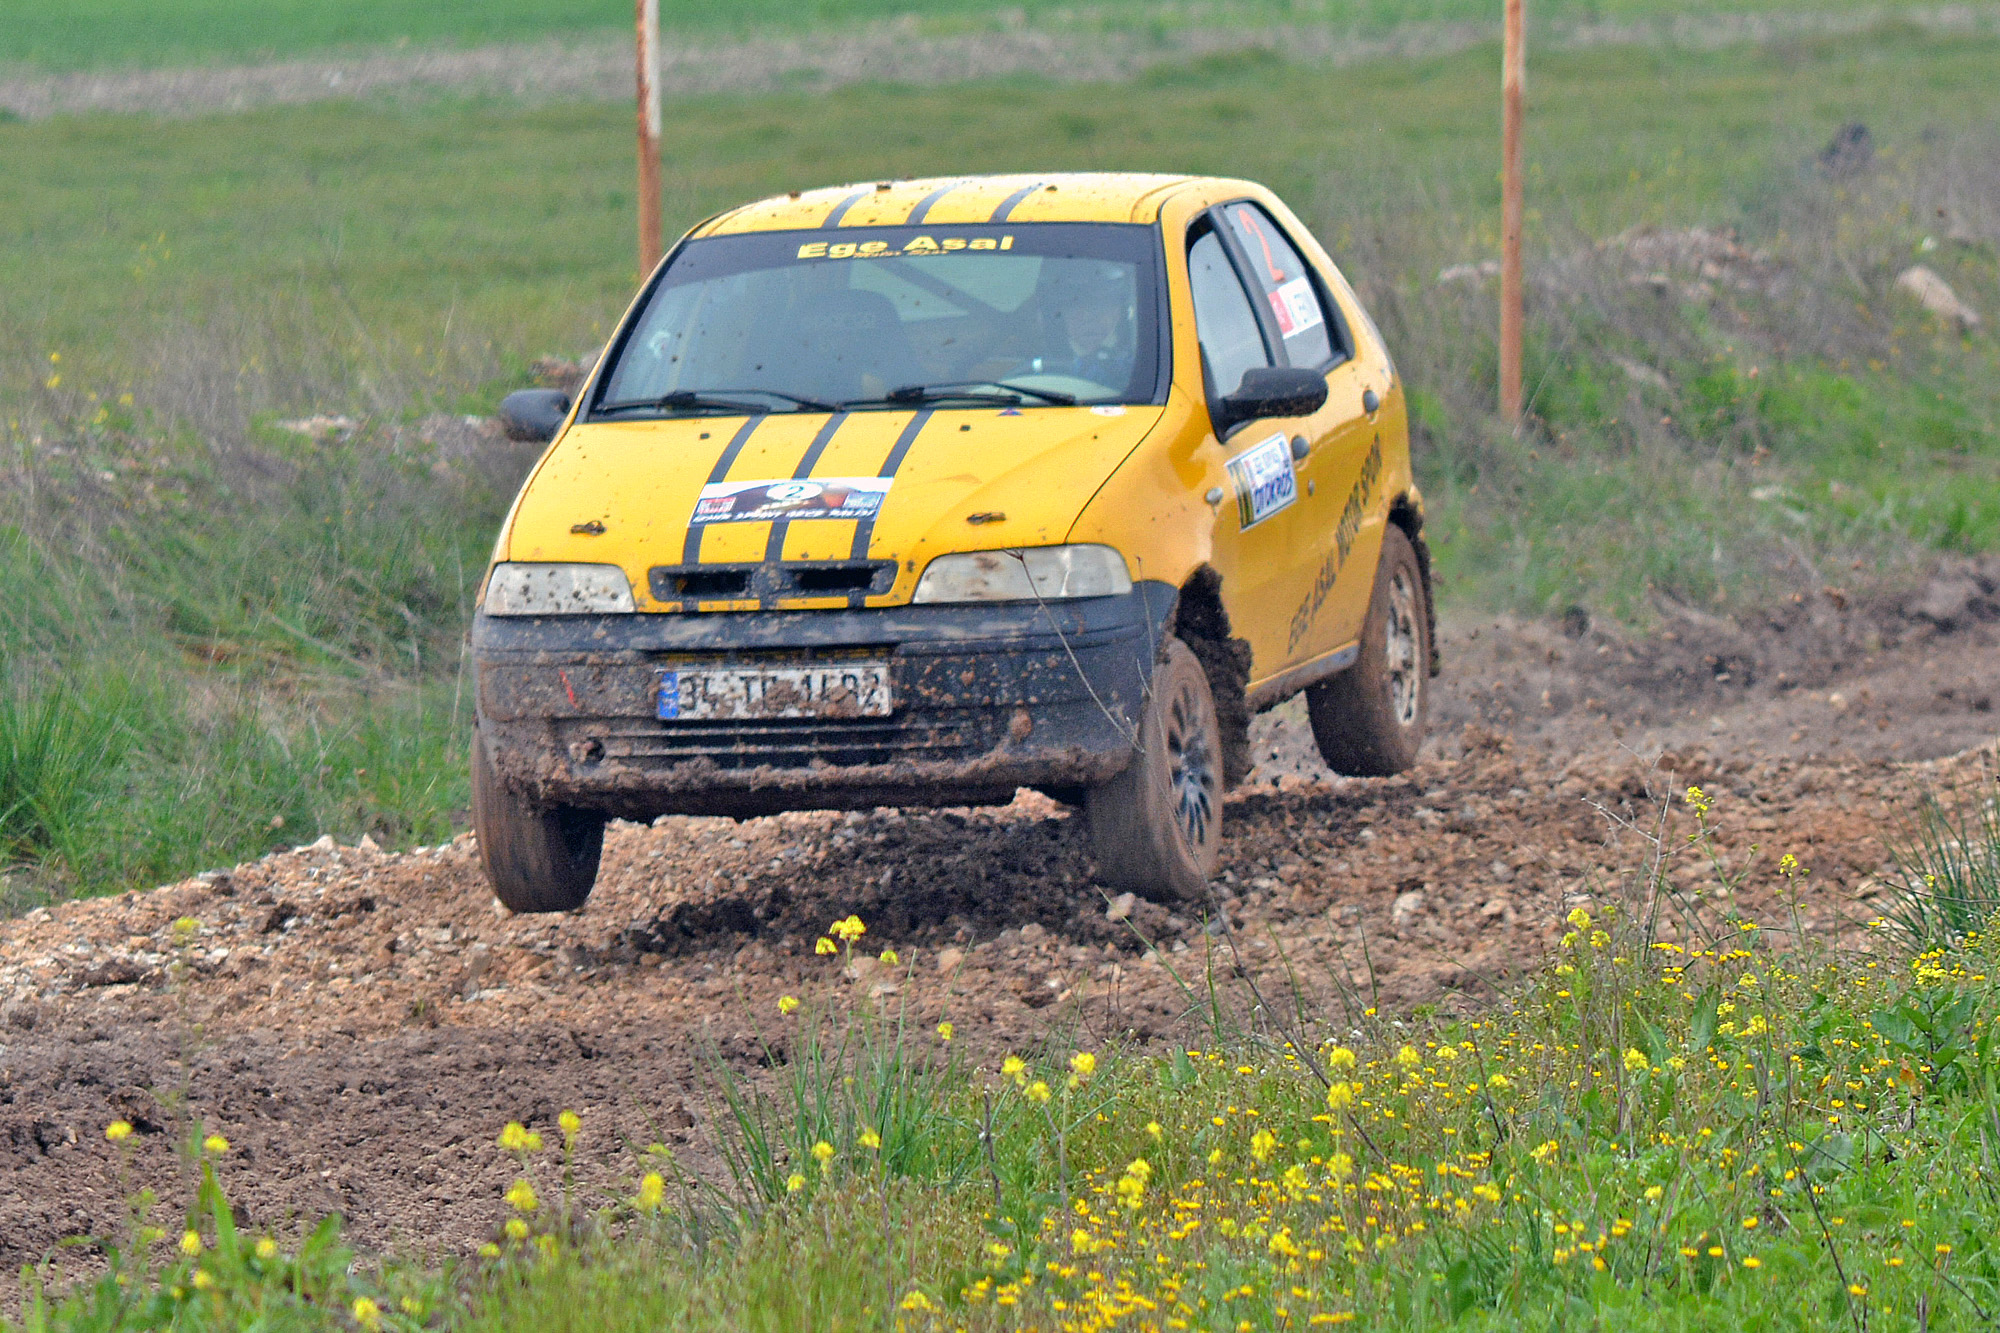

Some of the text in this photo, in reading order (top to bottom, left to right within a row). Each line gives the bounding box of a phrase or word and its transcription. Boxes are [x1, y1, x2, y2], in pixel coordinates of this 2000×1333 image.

[797, 235, 1014, 259] Ege Asal
[1238, 209, 1286, 282] 2
[786, 486, 804, 498] 2
